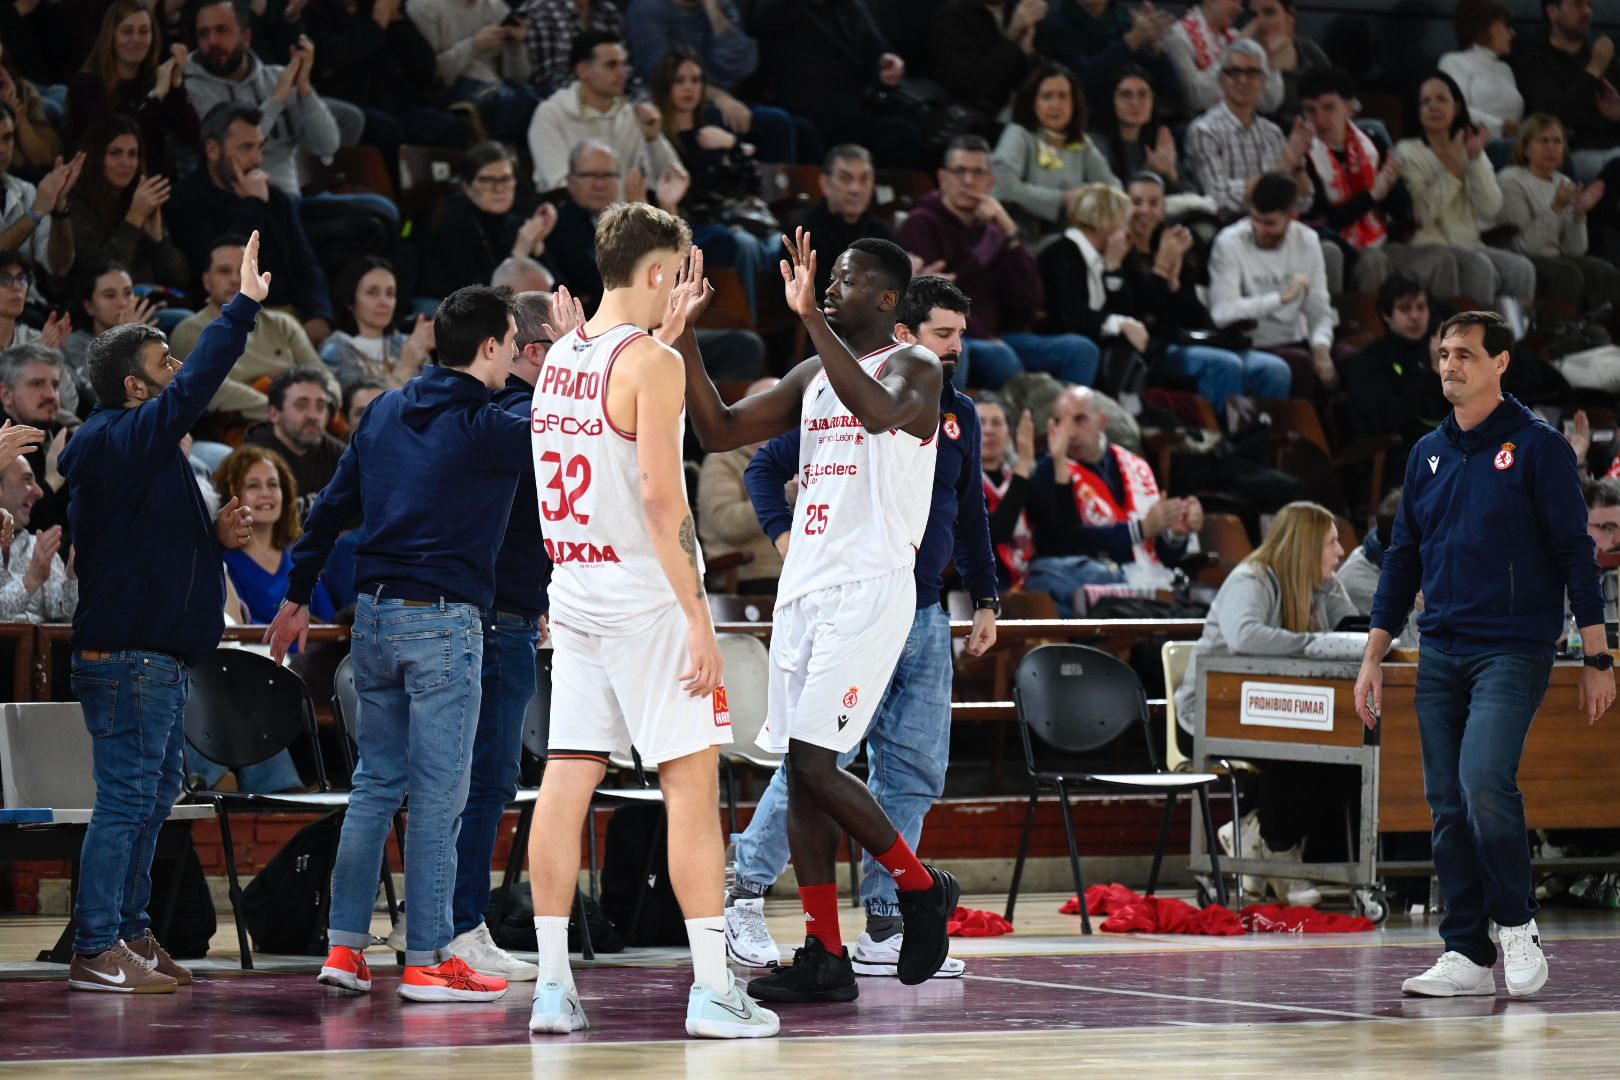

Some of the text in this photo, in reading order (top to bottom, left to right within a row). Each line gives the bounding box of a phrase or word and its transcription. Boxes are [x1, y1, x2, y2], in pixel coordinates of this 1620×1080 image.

[540, 450, 592, 526] 32
[804, 504, 830, 535] 25
[1249, 696, 1324, 715] PROHIBIDO FUMAR
